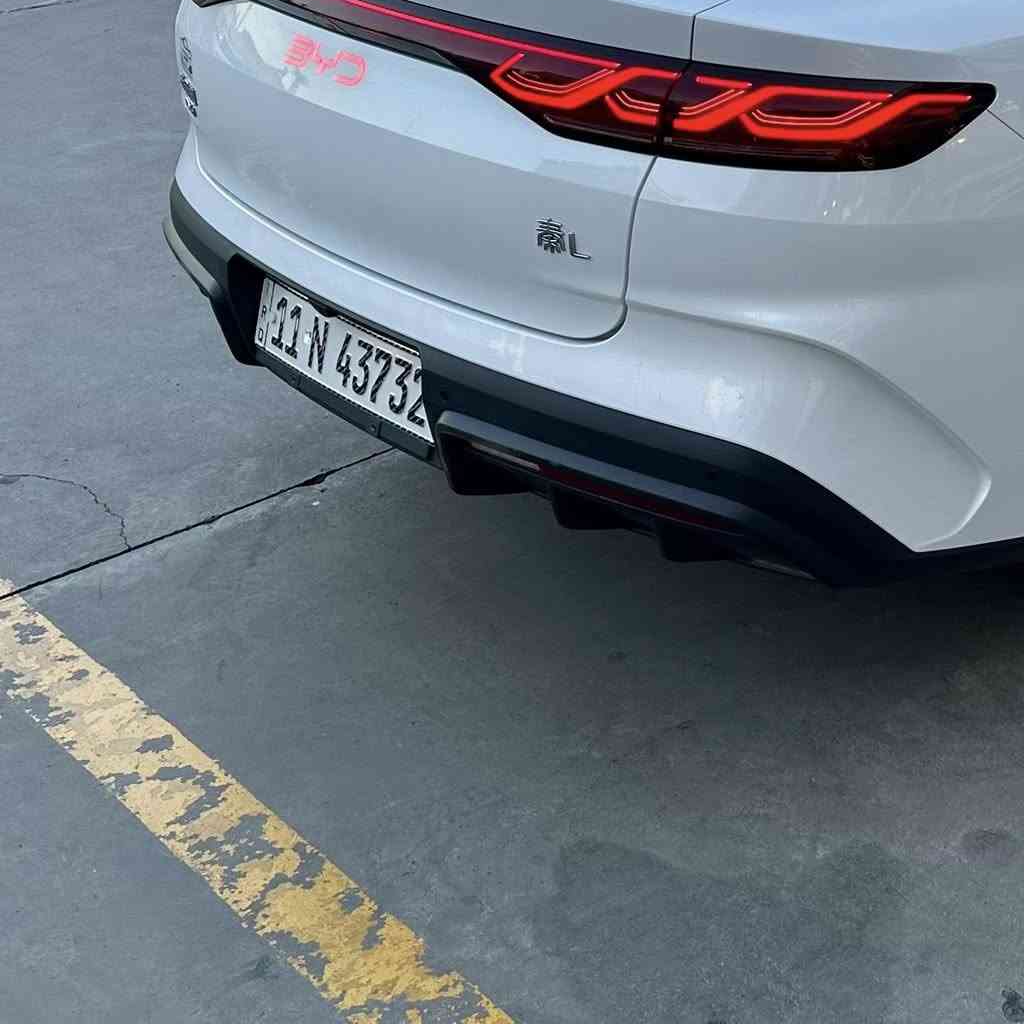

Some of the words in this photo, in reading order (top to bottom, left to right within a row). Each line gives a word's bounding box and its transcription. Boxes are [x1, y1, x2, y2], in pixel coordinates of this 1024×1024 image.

[284, 32, 368, 87] BYD
[271, 296, 303, 359] 11
[308, 315, 329, 375] N
[335, 332, 426, 428] 43732
